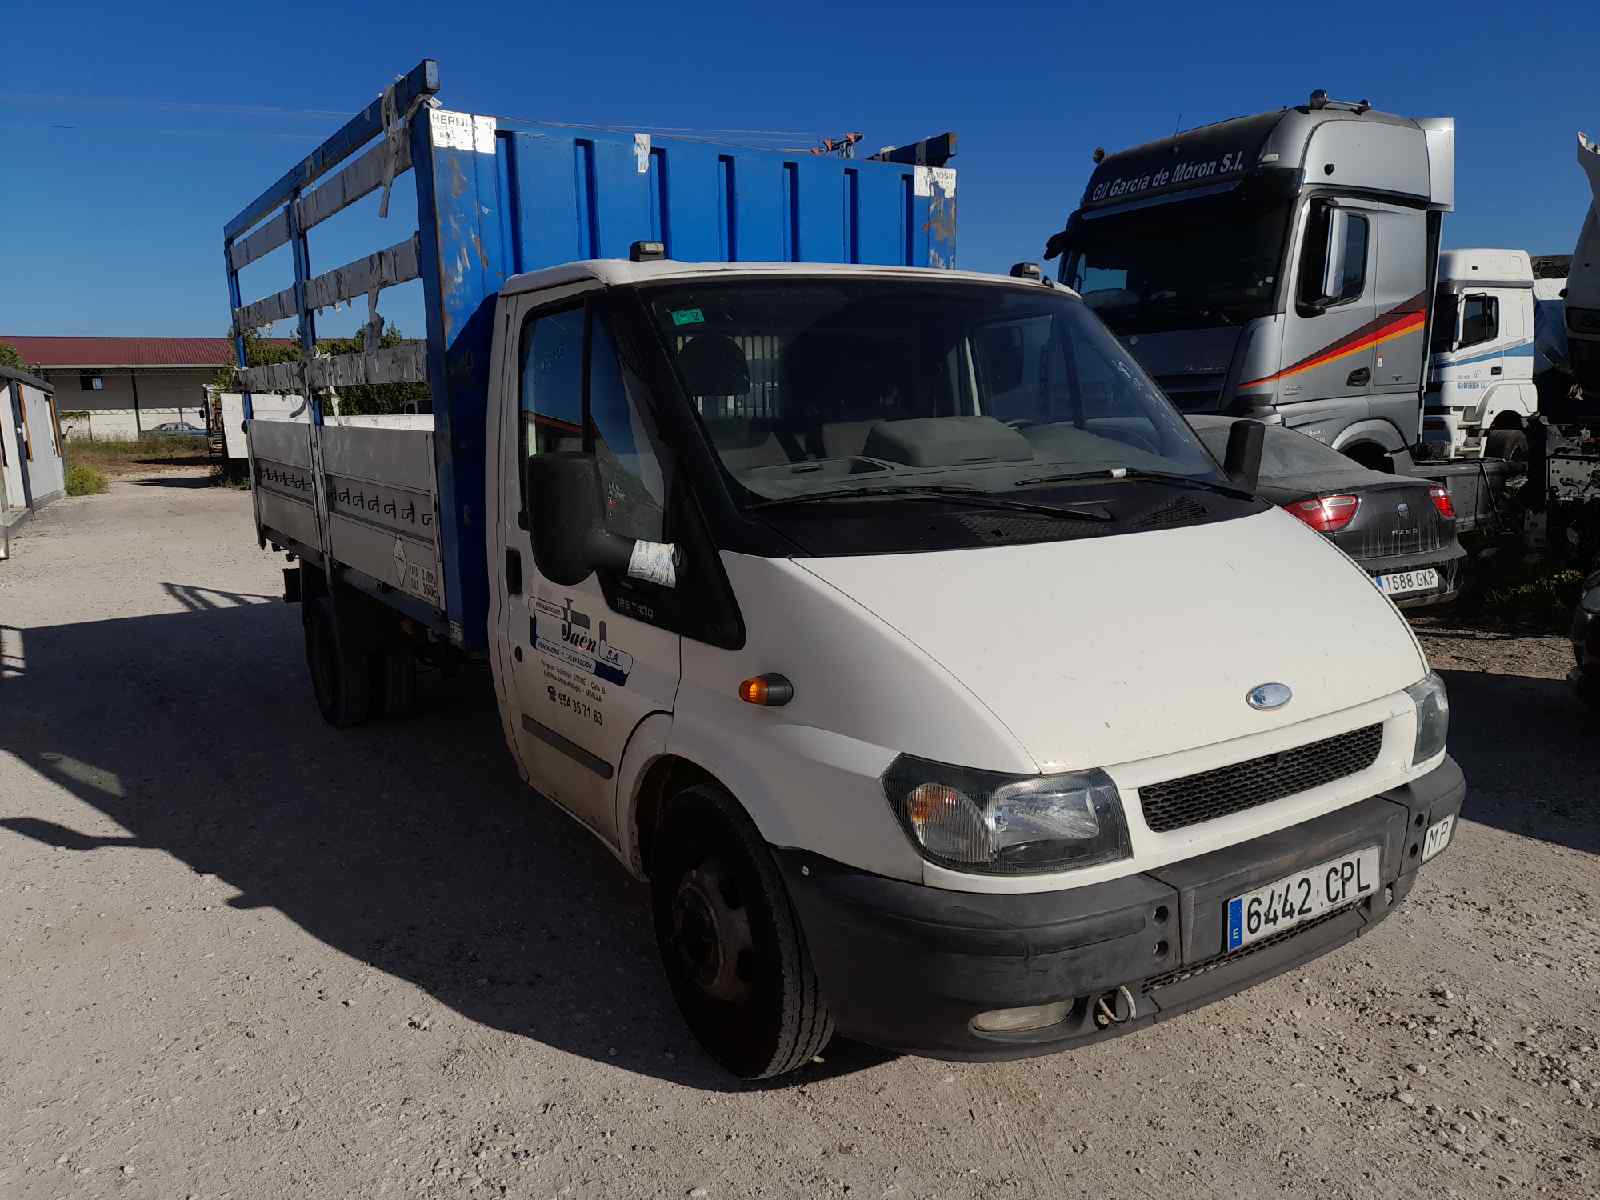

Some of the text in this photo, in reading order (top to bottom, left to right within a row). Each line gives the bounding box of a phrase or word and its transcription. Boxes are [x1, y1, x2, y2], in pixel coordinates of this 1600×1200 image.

[1093, 183, 1112, 201] Gil
[1152, 167, 1169, 187] de
[1246, 857, 1371, 934] 6442 CPL
